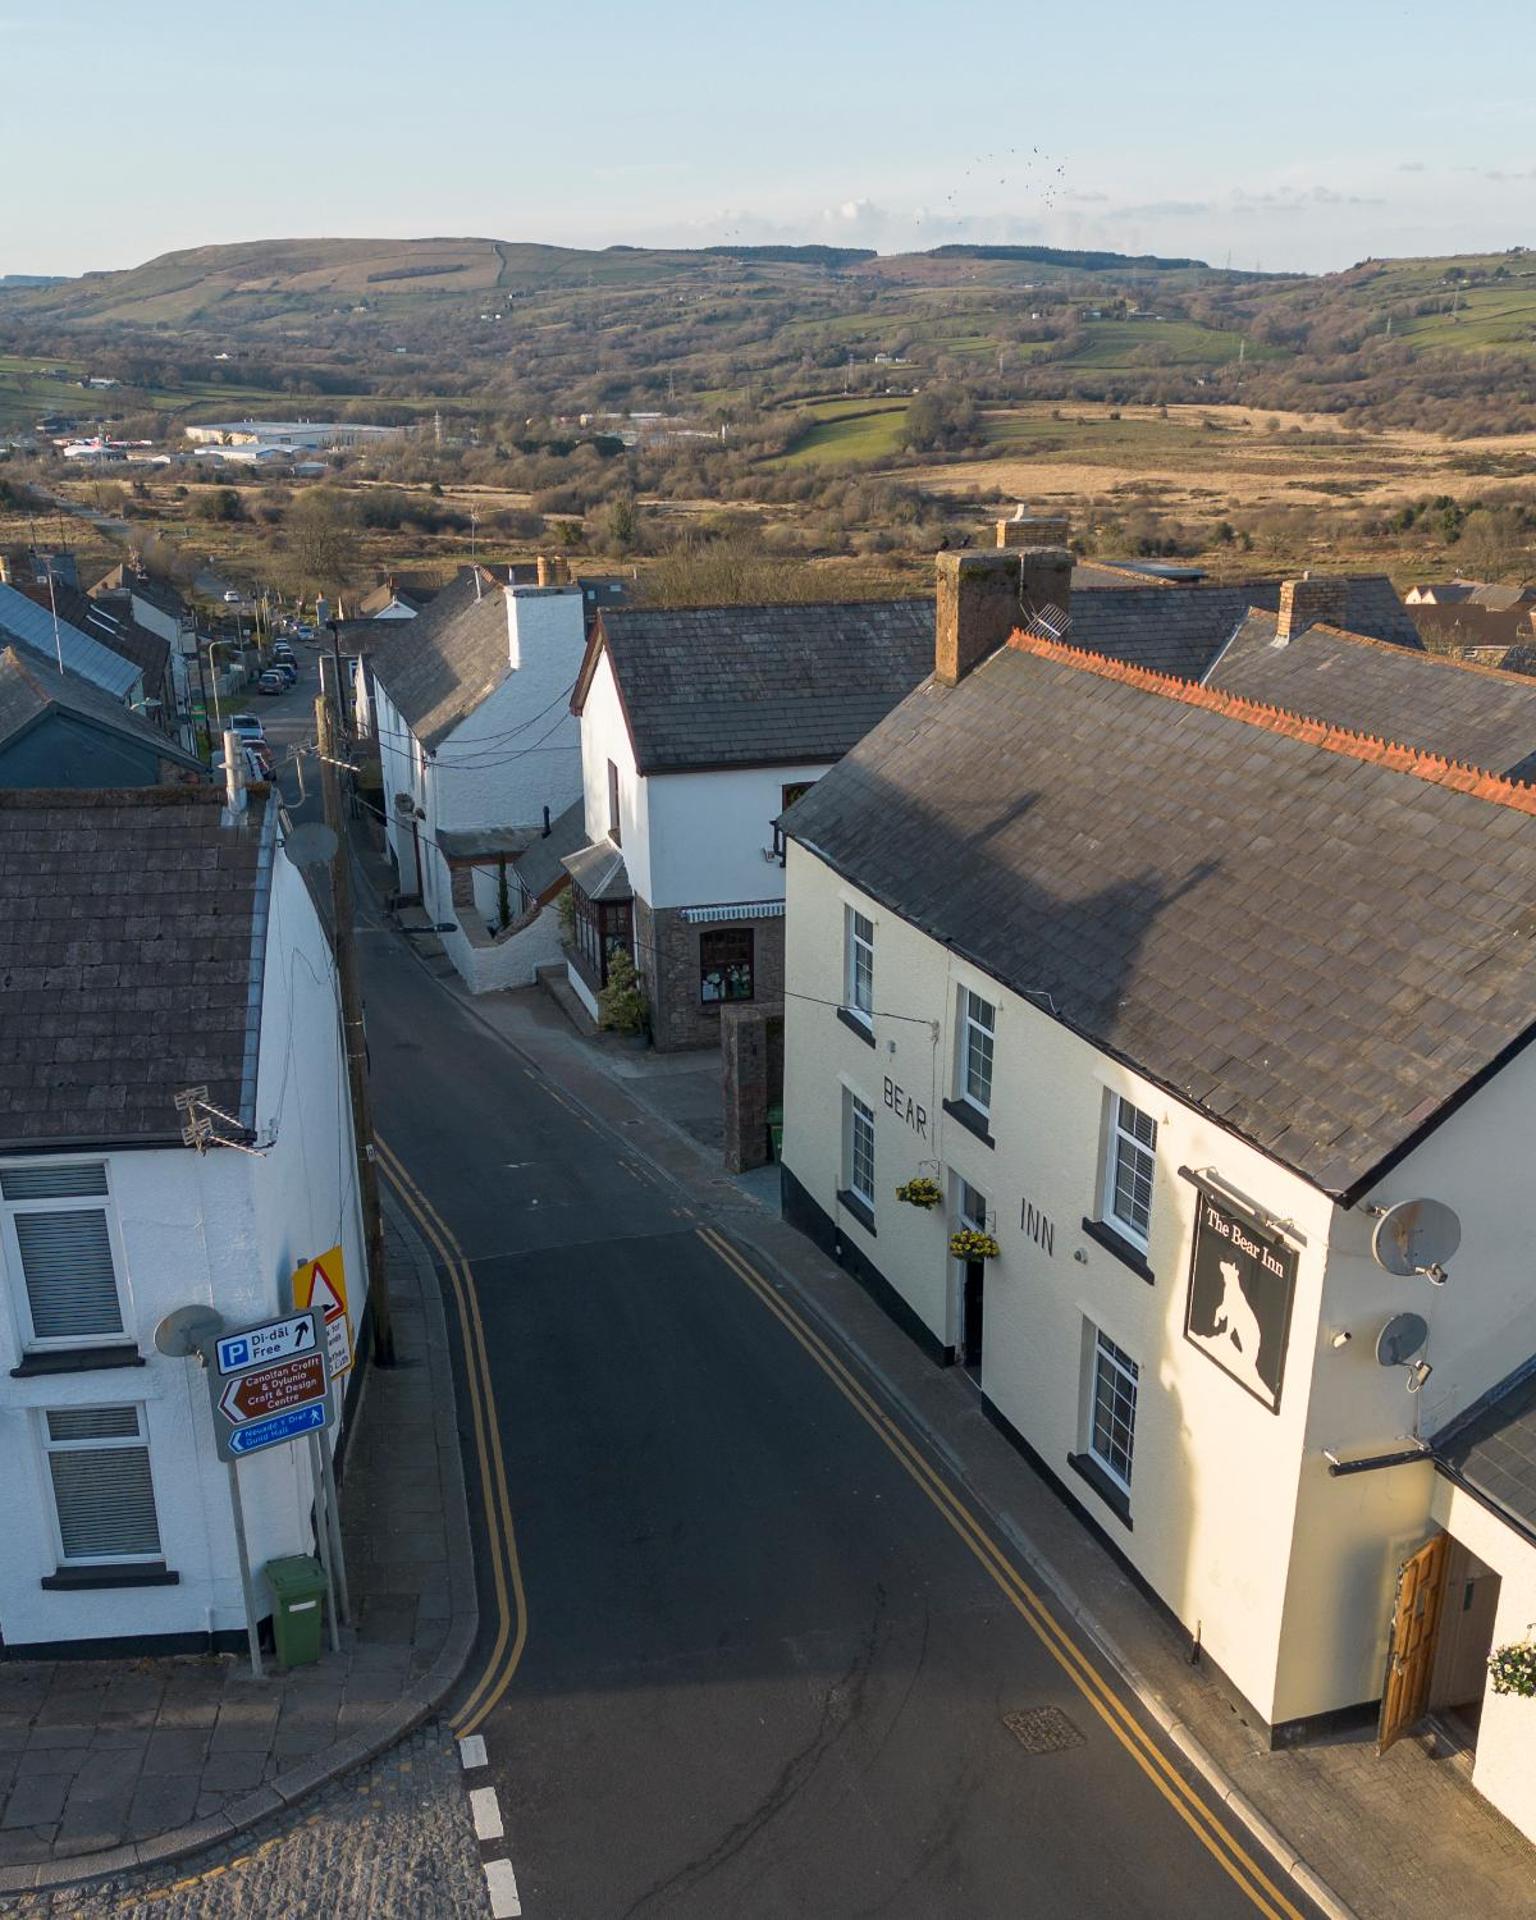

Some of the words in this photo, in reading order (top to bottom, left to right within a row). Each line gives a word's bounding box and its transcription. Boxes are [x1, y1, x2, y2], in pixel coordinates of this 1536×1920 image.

[883, 1075, 927, 1140] BEAR
[1020, 1197, 1055, 1257] INN
[1206, 1207, 1230, 1238] The
[1231, 1224, 1261, 1260] Bear
[1261, 1246, 1284, 1279] Inn
[228, 1343, 244, 1364] P
[252, 1344, 281, 1359] Free
[246, 1368, 289, 1387] Canolfan
[291, 1357, 320, 1372] Crofft
[261, 1381, 269, 1392] &
[271, 1371, 308, 1389] Dylunio
[247, 1391, 273, 1406] Craft
[275, 1385, 284, 1398] &
[285, 1378, 317, 1394] Design
[267, 1394, 299, 1409] Centre
